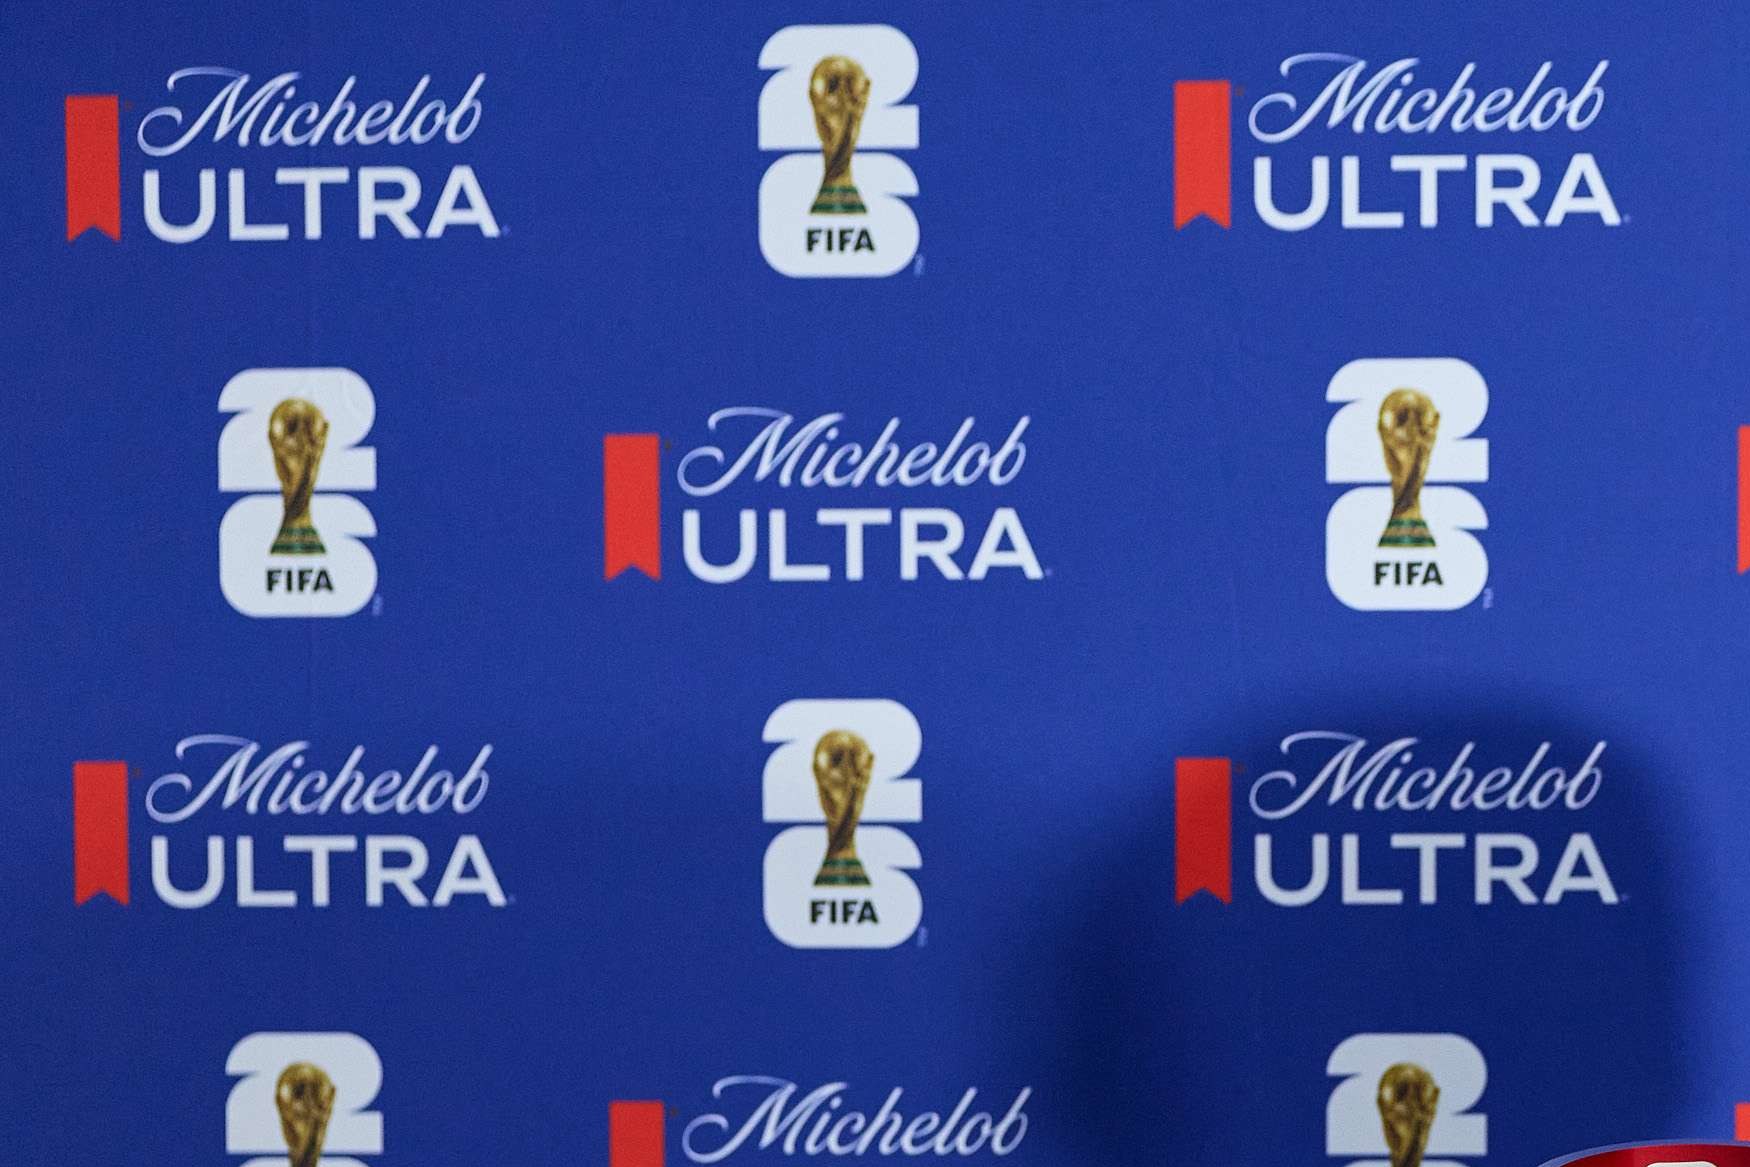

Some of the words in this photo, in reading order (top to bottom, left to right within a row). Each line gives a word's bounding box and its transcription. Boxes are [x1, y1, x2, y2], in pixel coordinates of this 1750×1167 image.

[138, 68, 485, 156] Michelob
[1249, 53, 1608, 143] Michelob
[144, 166, 500, 243] ULTRA
[1254, 154, 1621, 231] ULTRA
[807, 229, 875, 252] FIFA
[678, 407, 1030, 496] Michelob
[267, 569, 333, 592] FIFA
[683, 508, 1043, 583] ULTRA
[1374, 562, 1443, 585] FIFA
[146, 735, 492, 823] Michelob
[1249, 731, 1607, 819] Michelob
[152, 836, 506, 908] ULTRA
[1255, 834, 1618, 906] ULTRA
[810, 900, 878, 924] FIFA
[683, 1076, 1030, 1163] Michelob
